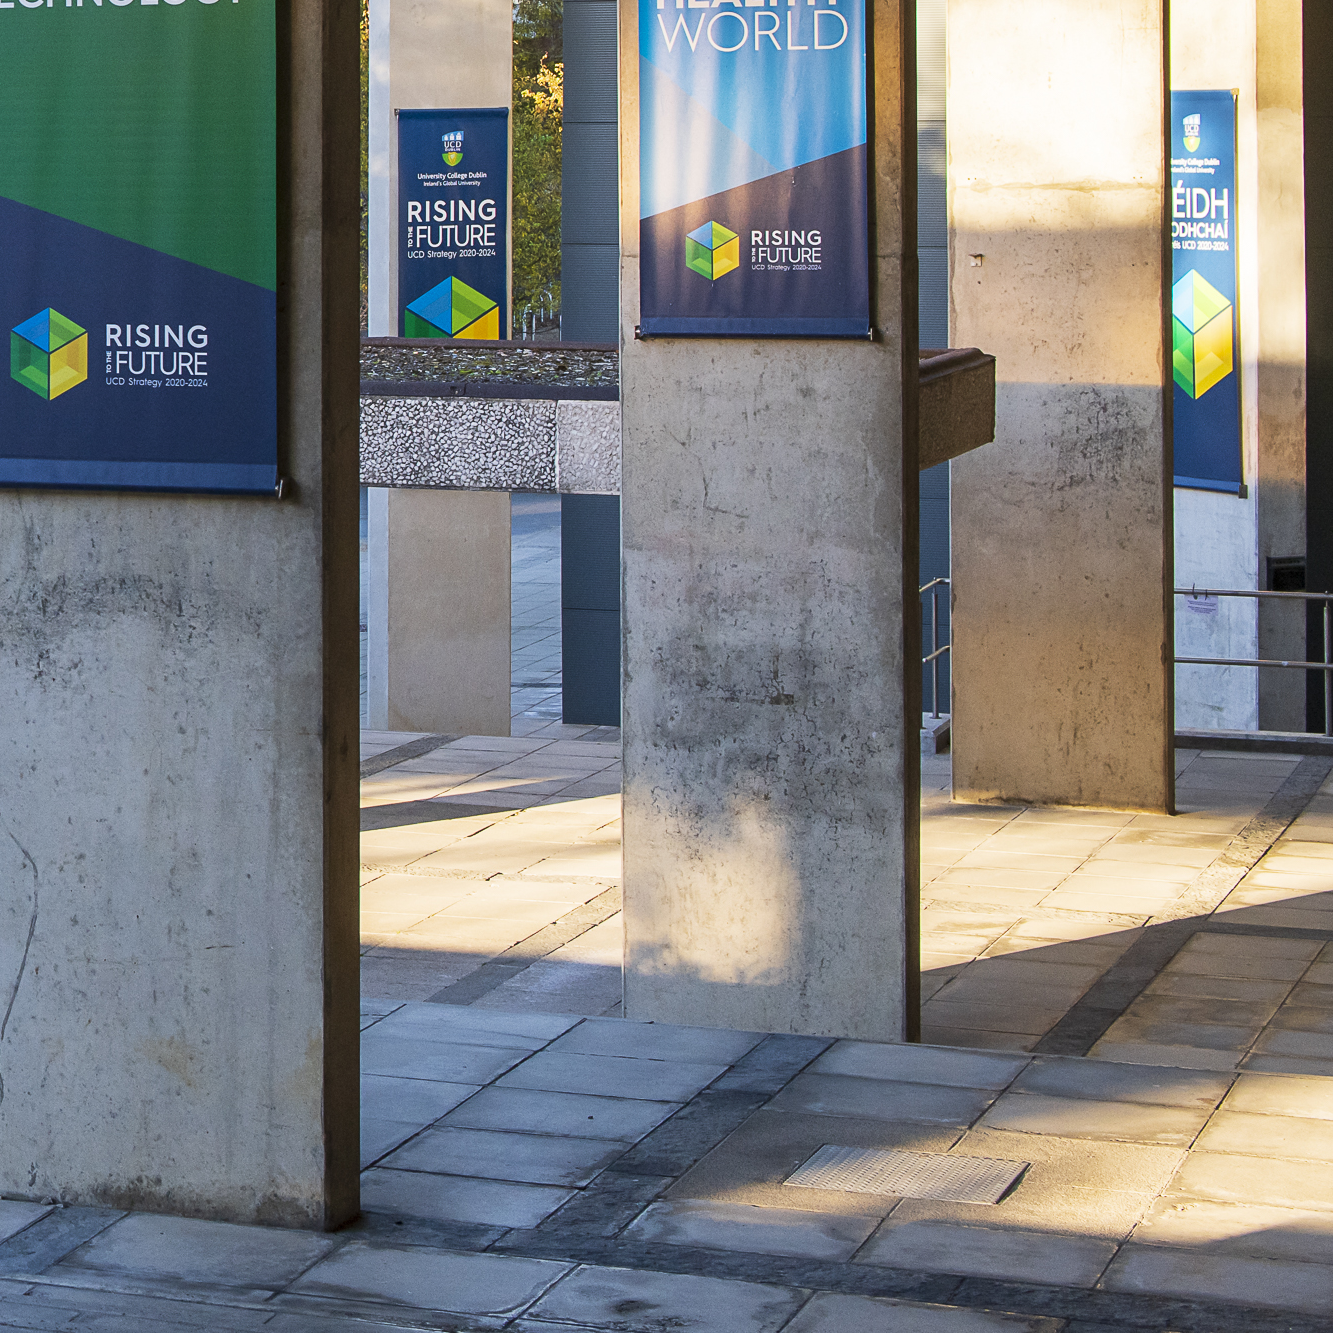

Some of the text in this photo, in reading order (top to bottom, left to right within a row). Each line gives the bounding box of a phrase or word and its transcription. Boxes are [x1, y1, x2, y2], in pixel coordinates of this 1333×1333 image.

[657, 9, 849, 54] WORLD
[447, 172, 467, 180] College
[1172, 180, 1229, 219] ÉIDH
[408, 199, 496, 222] RISING
[416, 224, 496, 248] FUTURE
[1171, 220, 1229, 238] ODHCHAÍ
[751, 230, 822, 246] RISING
[1182, 240, 1196, 249] UCD
[408, 249, 496, 259] UCD Strategy 2020-2024
[758, 247, 822, 263] FUTURE
[106, 324, 208, 348] RISING
[106, 364, 112, 373] TO
[116, 351, 208, 376] FUTURE
[106, 377, 208, 388] UCD Strategy 2020-2024
